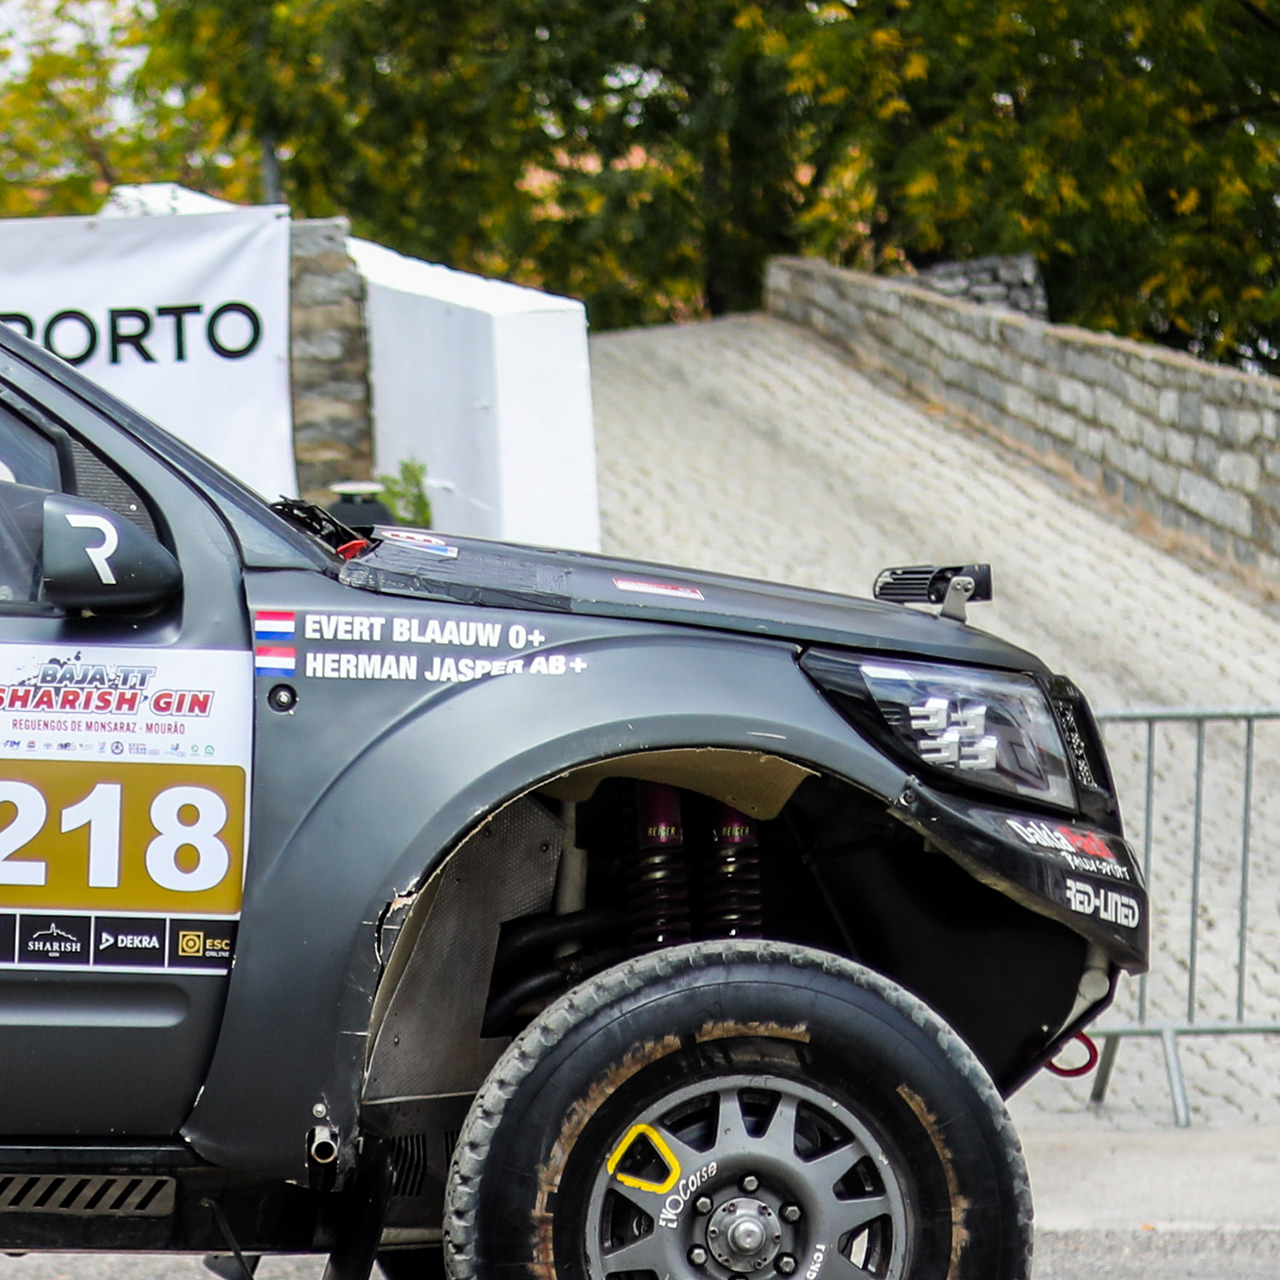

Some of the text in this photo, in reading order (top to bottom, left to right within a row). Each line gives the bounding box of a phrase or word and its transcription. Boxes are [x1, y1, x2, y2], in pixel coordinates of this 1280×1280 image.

[305, 615, 386, 641] EVERT
[393, 618, 502, 648] BLAAUW
[40, 665, 155, 688] BAJA TT
[305, 653, 417, 680] HERMAN
[424, 658, 523, 682] JASPER
[152, 691, 212, 714] GIN
[12, 719, 68, 731] REGUENGOS
[71, 720, 83, 732] DE
[85, 721, 137, 733] MONSARAZ
[145, 721, 185, 735] MOURÃO
[1066, 878, 1139, 929] RED-LINED
[28, 941, 81, 952] SHARISH
[117, 935, 159, 948] DEKRA
[206, 940, 230, 950] ESC
